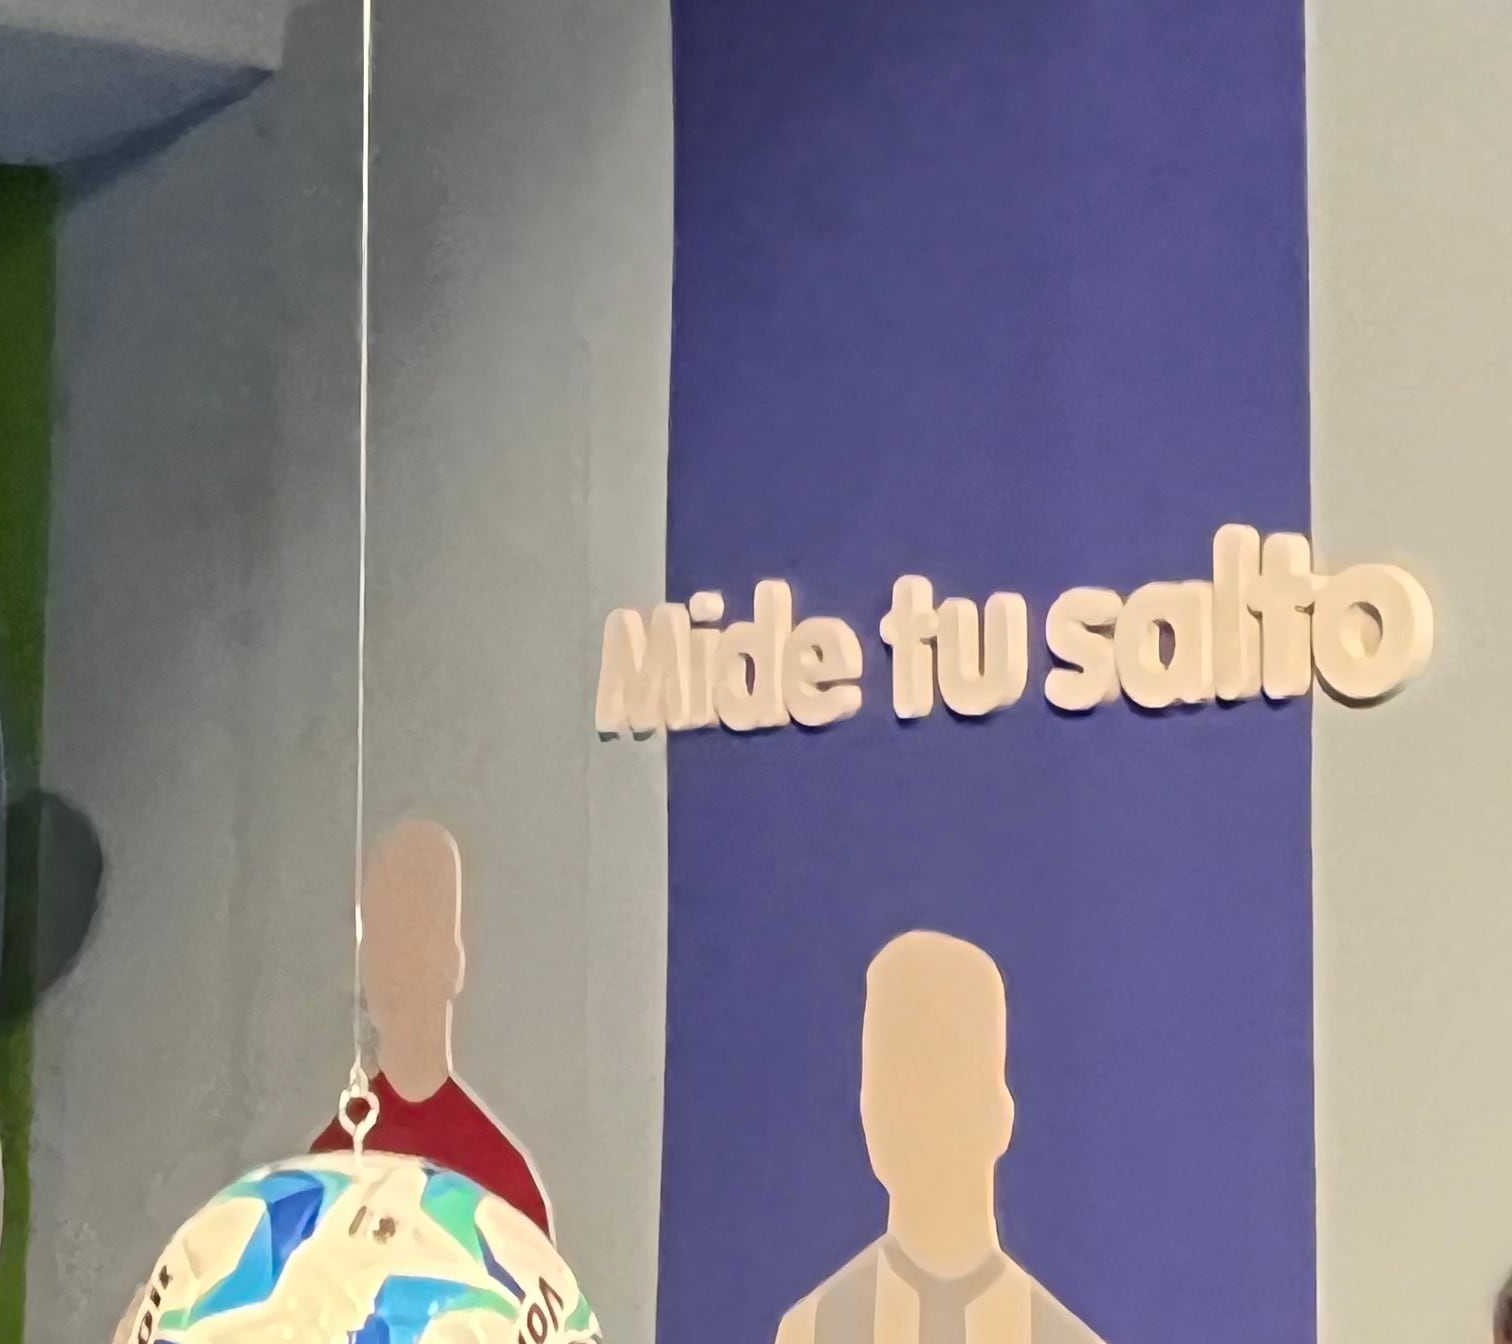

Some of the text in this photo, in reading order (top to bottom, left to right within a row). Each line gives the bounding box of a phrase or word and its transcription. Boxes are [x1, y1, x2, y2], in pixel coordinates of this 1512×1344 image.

[596, 522, 1434, 735] Mide tu salto
